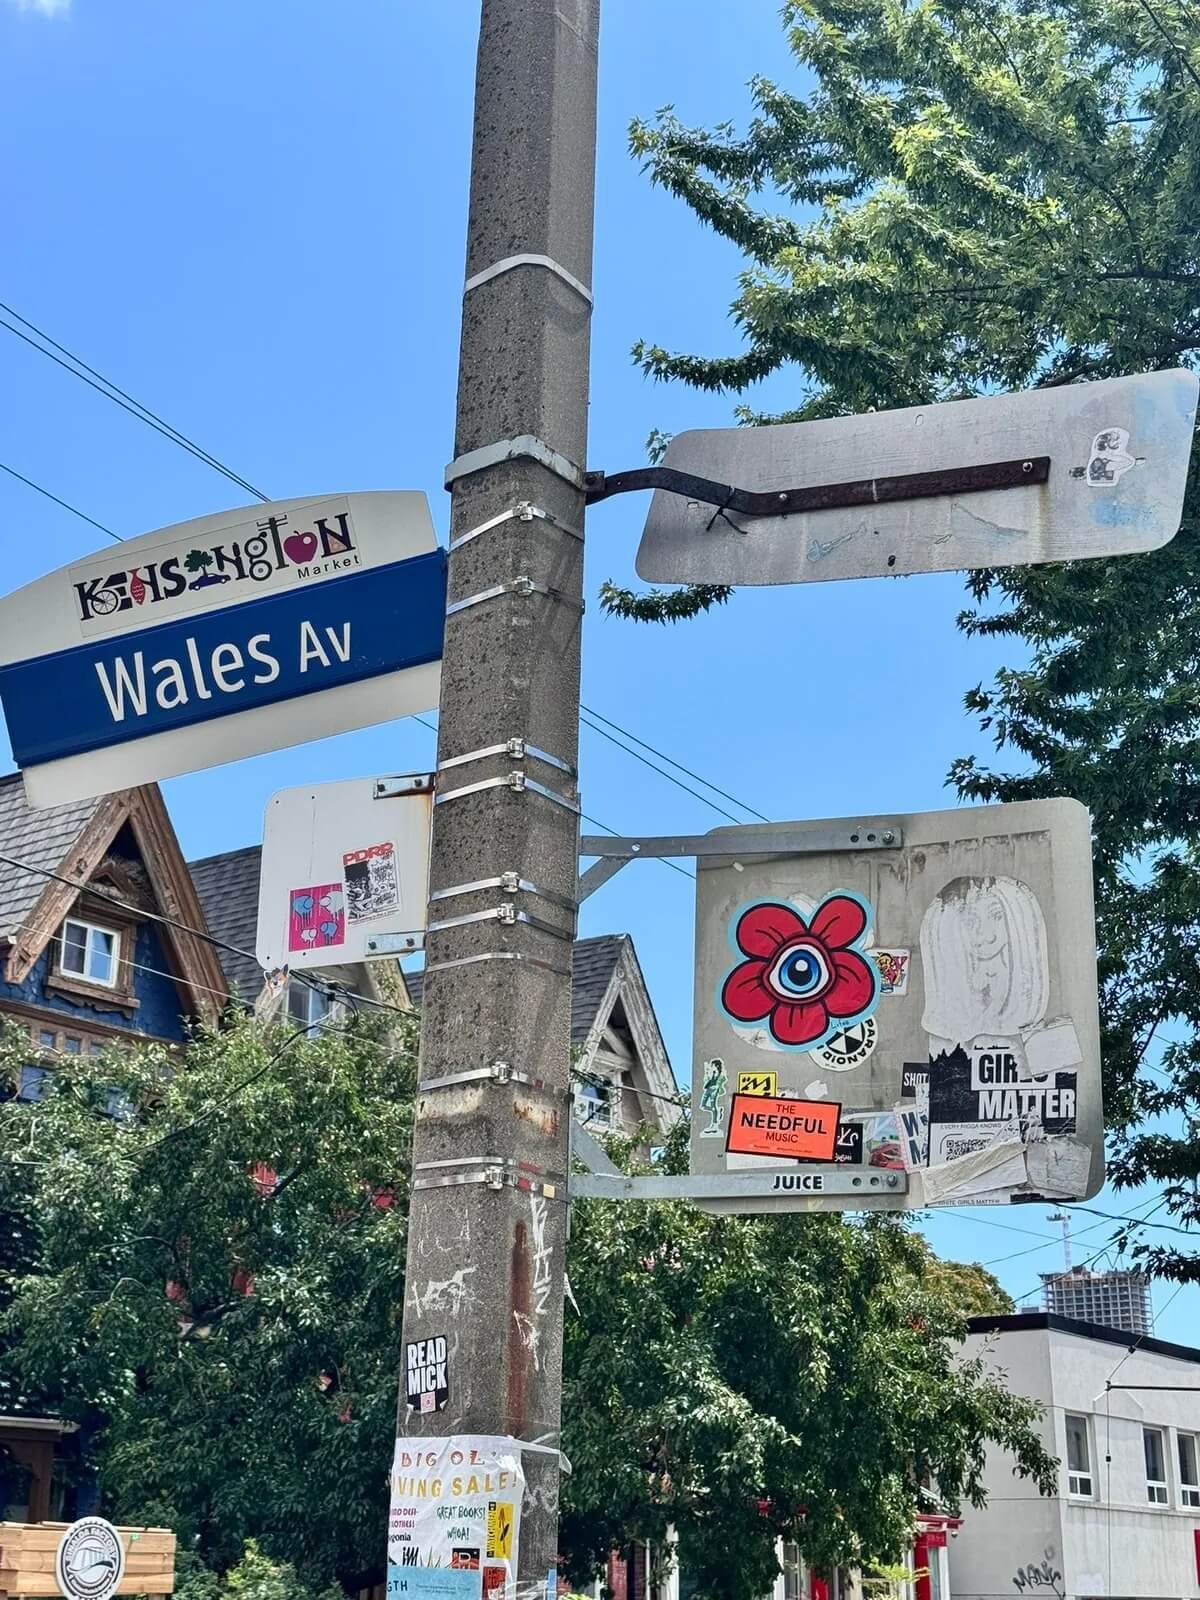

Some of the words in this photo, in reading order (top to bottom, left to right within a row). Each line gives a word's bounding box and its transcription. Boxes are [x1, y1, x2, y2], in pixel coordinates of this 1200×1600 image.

[297, 555, 360, 579] Market
[95, 633, 280, 722] Wales
[300, 621, 351, 673] Av
[776, 1104, 797, 1115] THE
[978, 1088, 1076, 1121] MATTER
[741, 1112, 827, 1135] NEEDFUL
[765, 1131, 799, 1143] MUSIC
[773, 1176, 823, 1189] JUICE
[407, 1336, 446, 1369] READ
[408, 1362, 448, 1395] MICK
[401, 1452, 437, 1468] BIG
[392, 1475, 442, 1497] VING
[451, 1471, 517, 1497] SALE!
[436, 1505, 457, 1520] GREAT
[458, 1506, 486, 1521] BOOKS!
